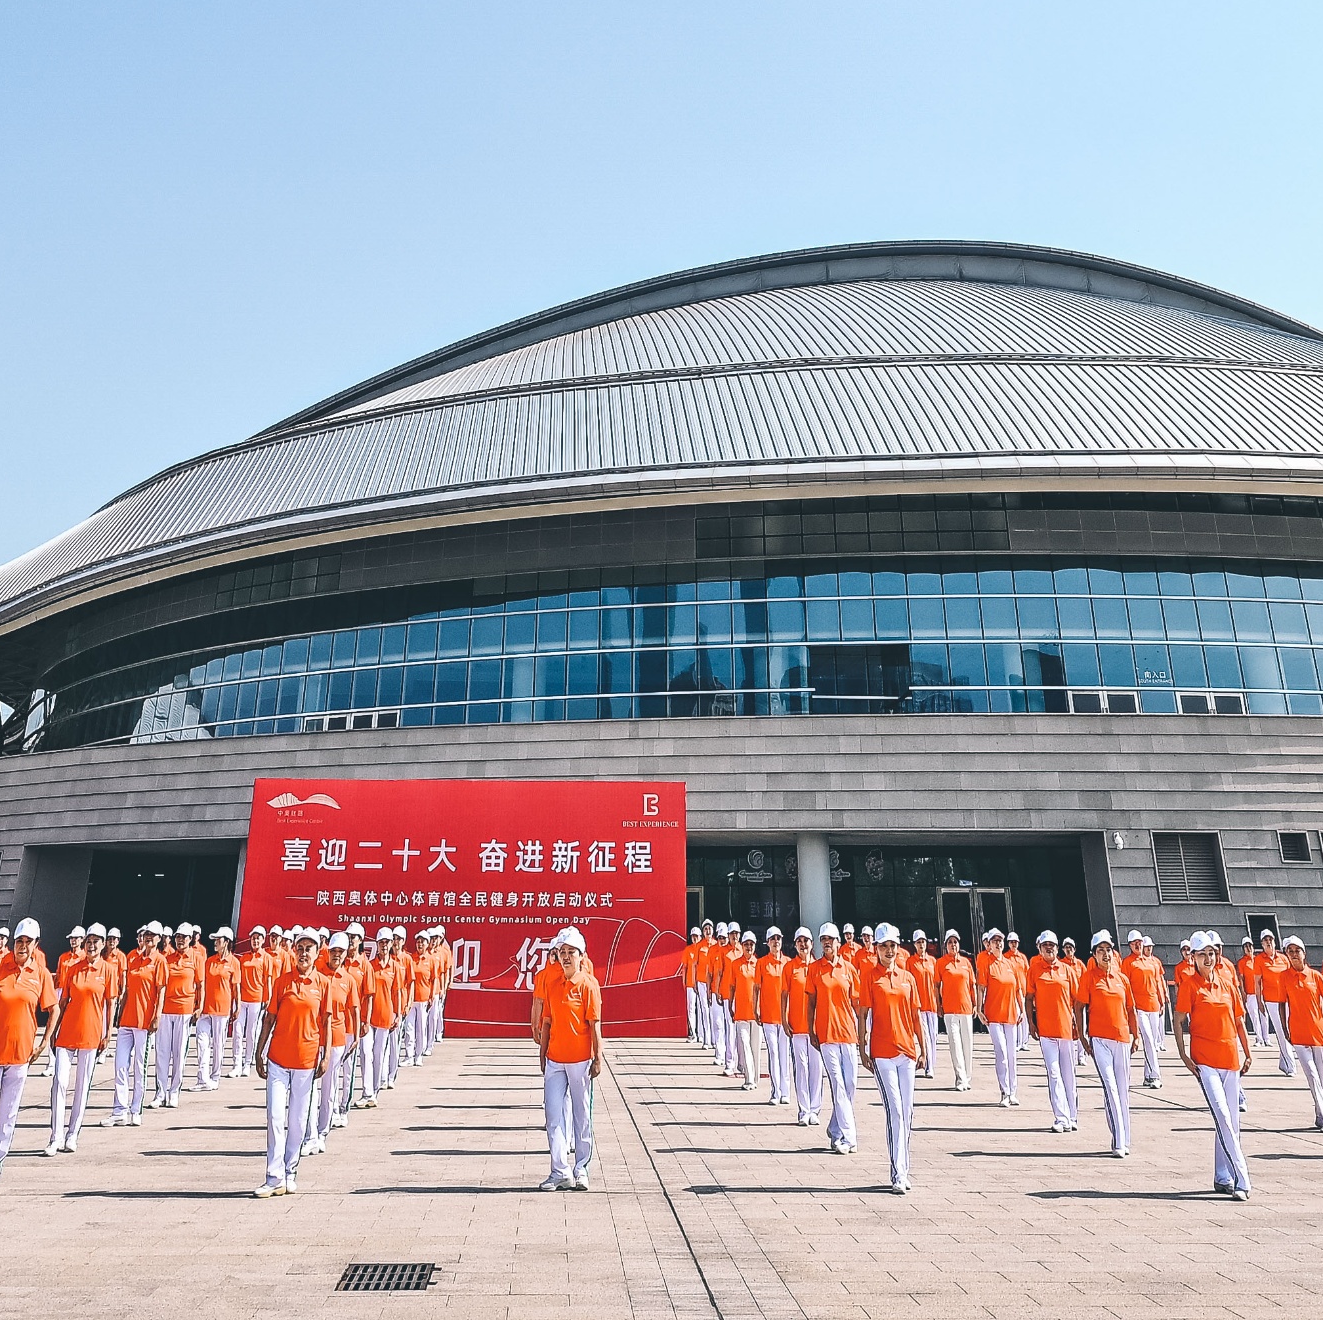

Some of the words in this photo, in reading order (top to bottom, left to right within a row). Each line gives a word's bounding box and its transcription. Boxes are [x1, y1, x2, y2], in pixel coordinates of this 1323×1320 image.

[280, 838, 457, 873] 喜迎二十大
[478, 839, 654, 874] 奋进新征程
[338, 914, 376, 923] Shaanxi
[379, 914, 417, 924] Olympic
[421, 915, 451, 924] Sports
[455, 915, 485, 923] Center
[489, 915, 542, 925] Gymnasium
[546, 916, 569, 925] Open
[573, 916, 590, 925] Day
